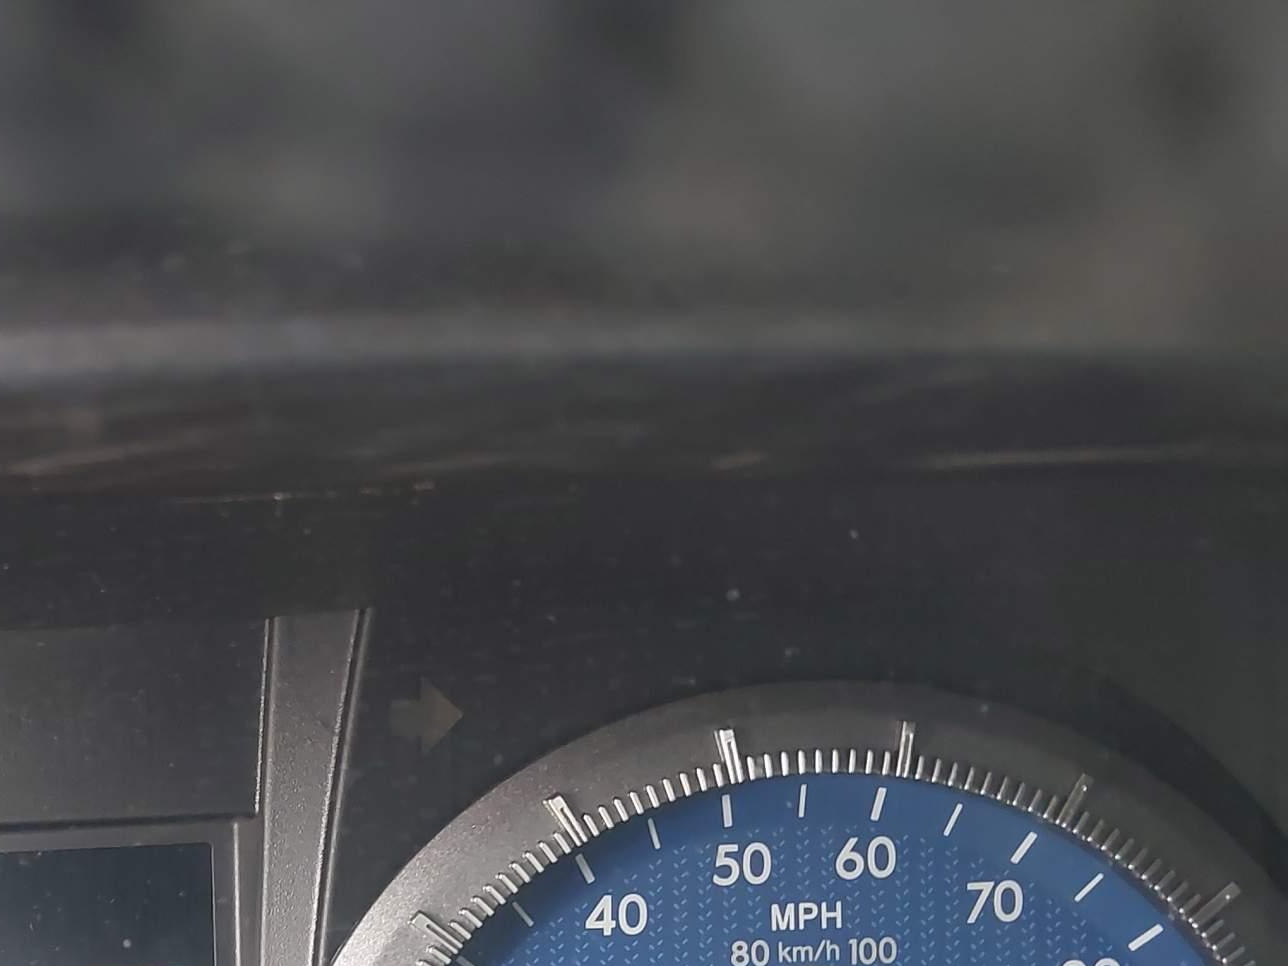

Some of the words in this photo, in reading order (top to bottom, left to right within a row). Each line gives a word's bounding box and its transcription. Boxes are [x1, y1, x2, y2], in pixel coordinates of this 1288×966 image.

[712, 842, 772, 886] 50
[835, 836, 897, 880] 60
[585, 894, 648, 936] 40
[770, 902, 842, 931] MPH
[966, 880, 1023, 923] 70
[731, 940, 769, 966] 80
[778, 939, 840, 963] km/h
[849, 937, 897, 965] 100
